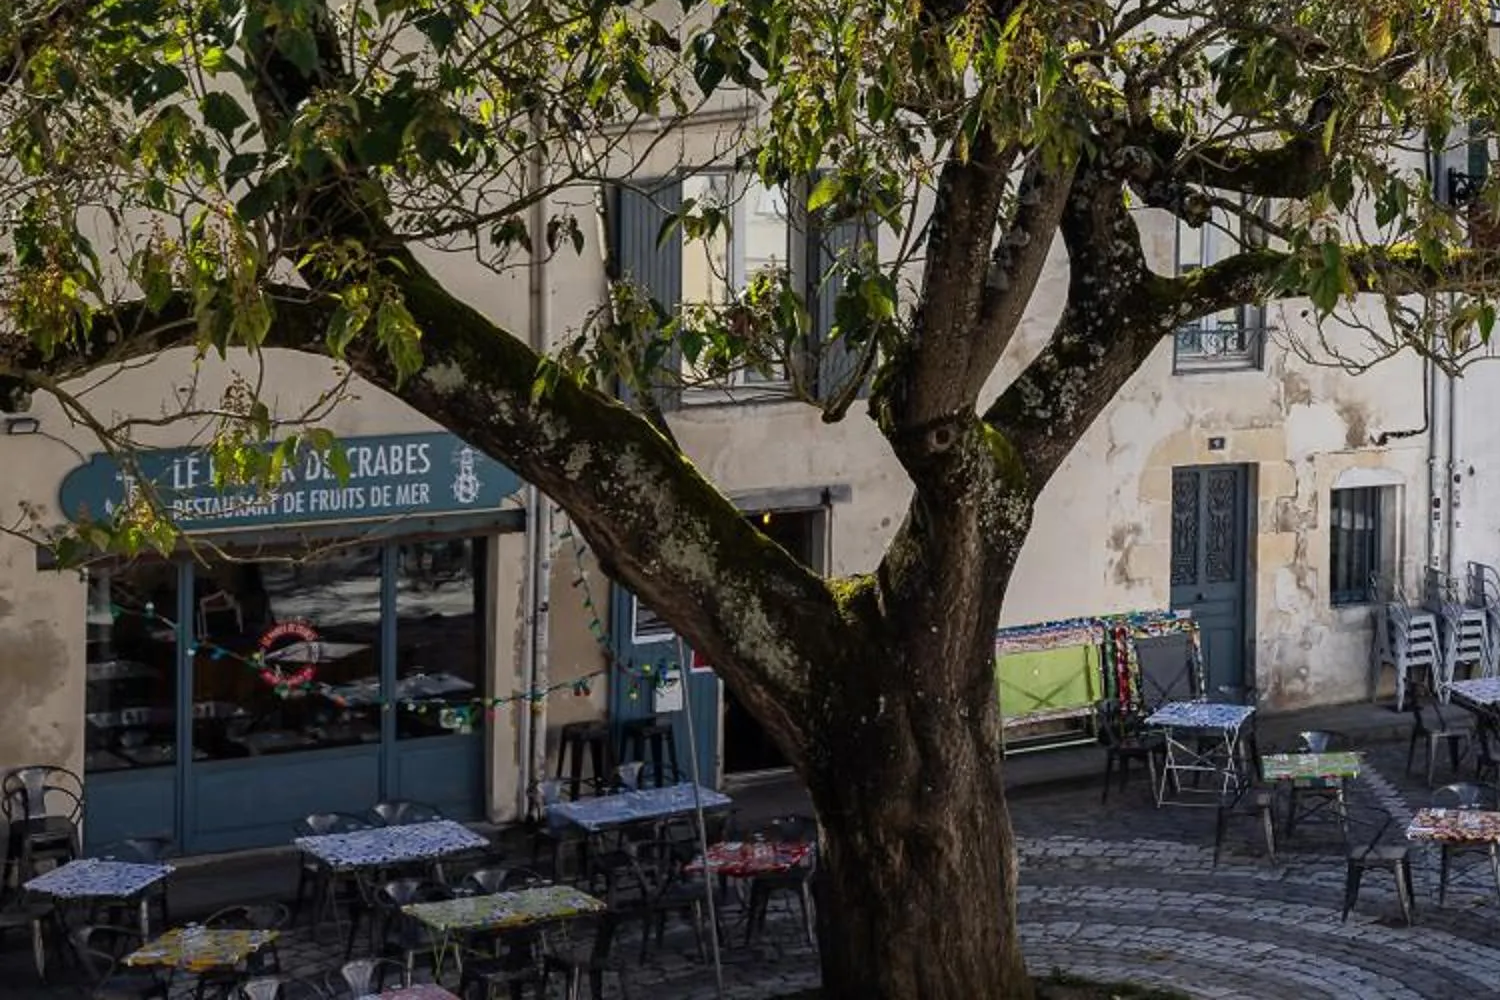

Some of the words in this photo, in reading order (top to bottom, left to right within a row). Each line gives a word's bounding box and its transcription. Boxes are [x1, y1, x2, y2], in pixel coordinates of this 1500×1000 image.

[173, 457, 200, 489] LE
[346, 443, 431, 479] CRABES
[173, 493, 279, 521] RESTAURANT
[283, 490, 305, 513] DE
[309, 486, 365, 512] FRUITS
[370, 485, 392, 508] DE
[396, 483, 430, 505] MER
